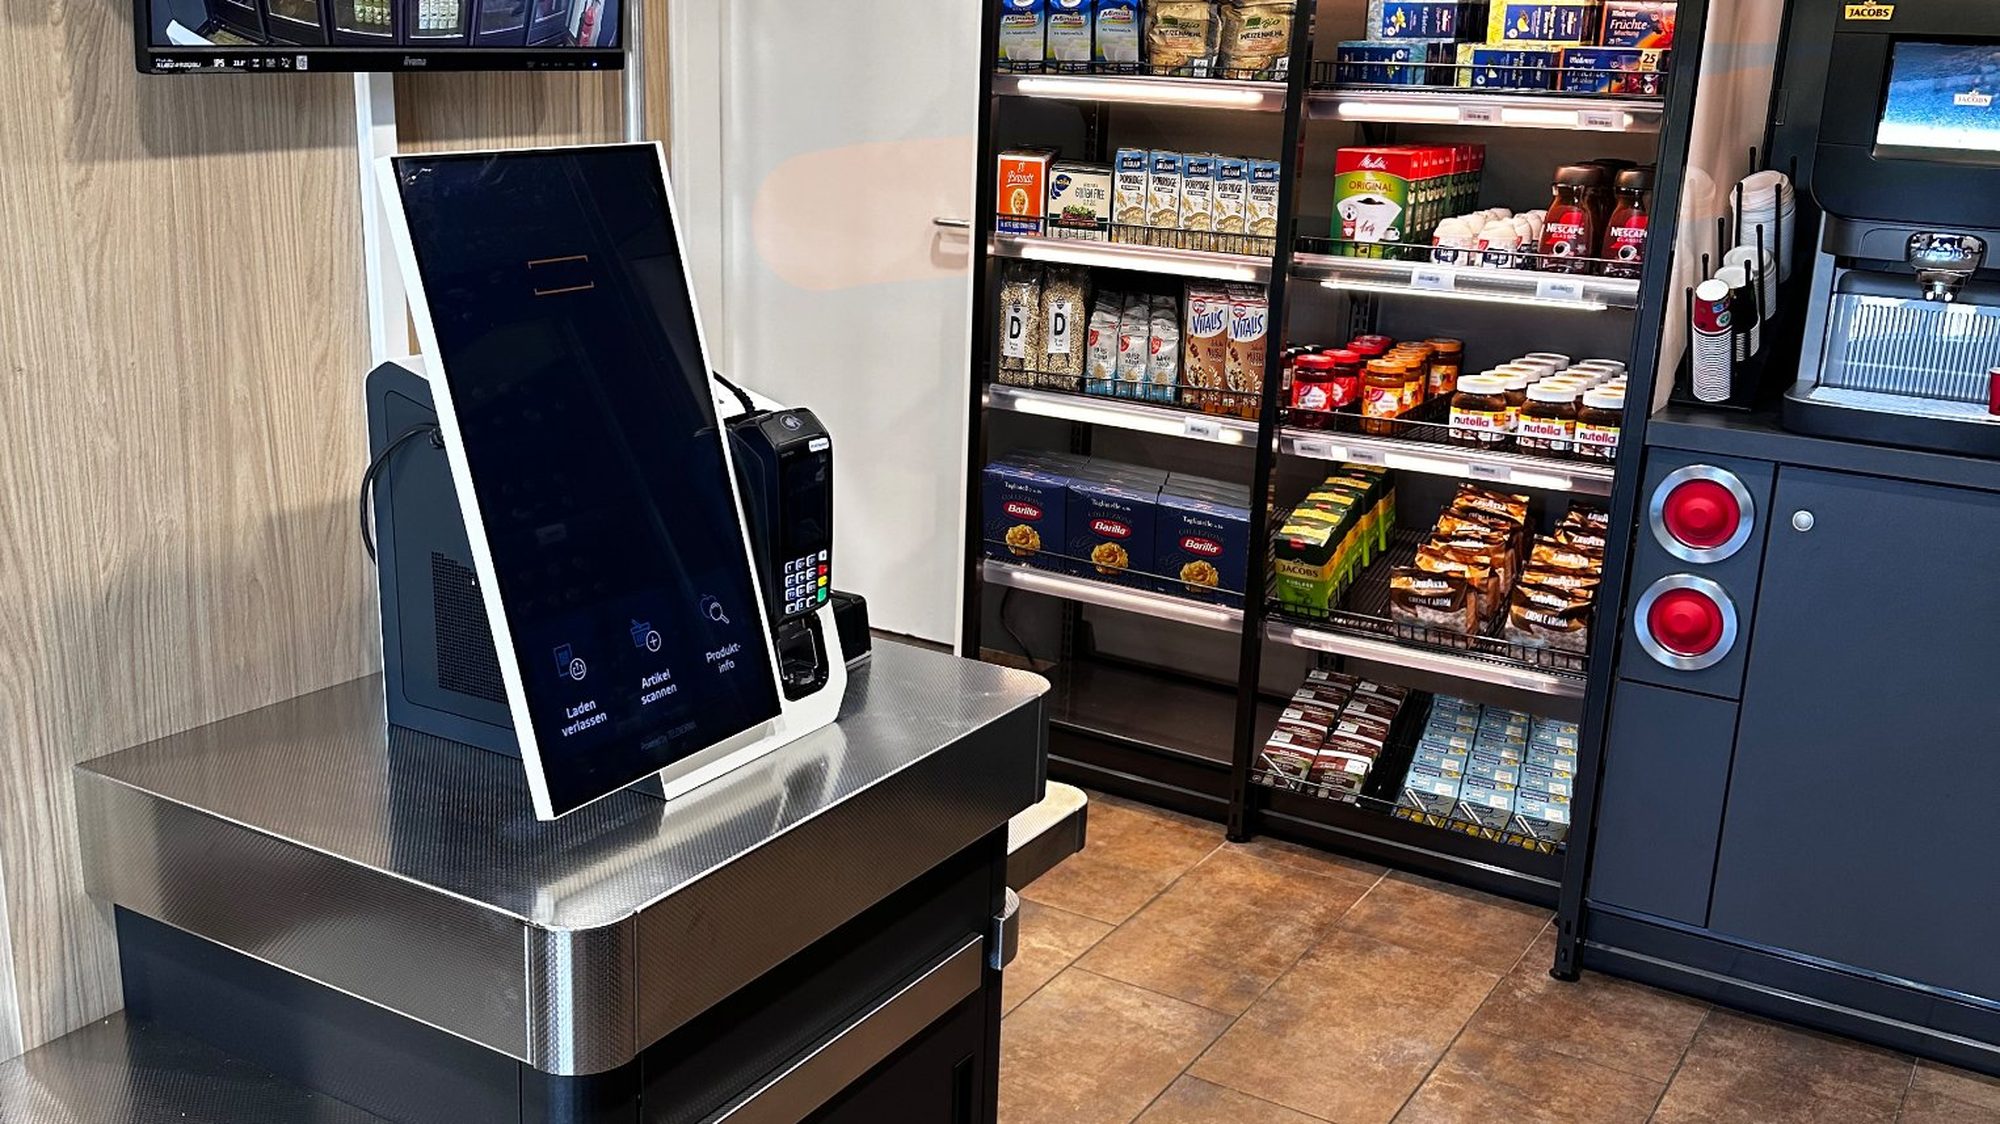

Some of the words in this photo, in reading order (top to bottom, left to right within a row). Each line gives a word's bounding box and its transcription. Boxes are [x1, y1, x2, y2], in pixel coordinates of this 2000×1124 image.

[1848, 8, 1890, 17] JACOBS
[1610, 19, 1650, 30] Früchte-
[1240, 30, 1285, 40] WEIZENMEHL
[1642, 53, 1656, 64] 25
[1348, 180, 1393, 192] ORIGINAL
[1093, 189, 1105, 200] FREE
[1611, 227, 1647, 238] NESCAF
[1009, 316, 1021, 339] D
[1054, 313, 1066, 336] D
[1193, 309, 1223, 334] VITALIS
[1232, 313, 1264, 339] VITALIS
[1454, 416, 1489, 428] nutella
[1524, 423, 1562, 436] nutella
[1579, 430, 1617, 444] nutella
[1008, 504, 1039, 517] Barilla
[1587, 512, 1609, 523] LAVA
[1094, 521, 1126, 535] Barilla
[1185, 539, 1217, 553] Barilla
[1280, 564, 1319, 577] JACOBS
[1413, 578, 1449, 588] LAVAZZA
[705, 643, 741, 664] Produkt-
[718, 660, 735, 674] info
[641, 669, 671, 690] Artikel
[640, 683, 677, 705] scannen
[566, 699, 597, 719] Laden
[561, 712, 607, 737] verlassen
